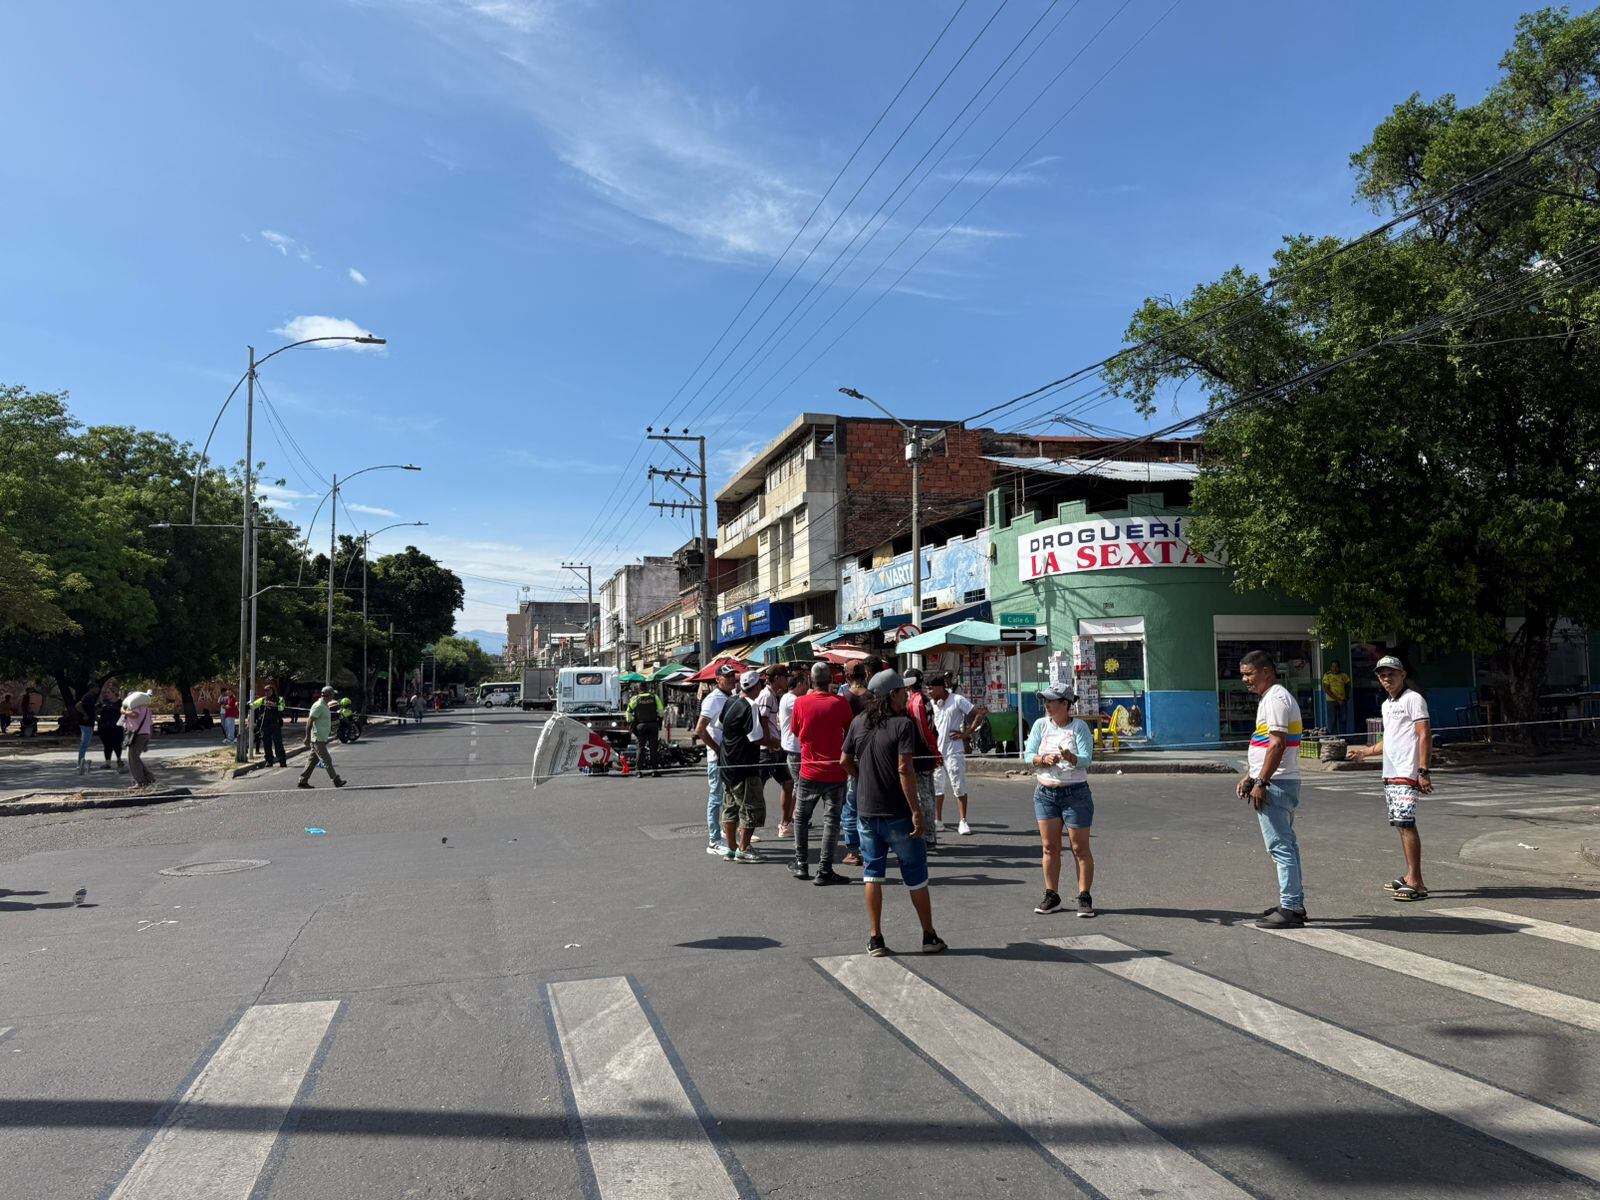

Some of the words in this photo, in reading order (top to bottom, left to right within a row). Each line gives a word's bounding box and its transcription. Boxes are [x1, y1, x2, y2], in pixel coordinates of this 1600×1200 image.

[1031, 517, 1181, 552] DROGUERÍ
[1031, 551, 1060, 576] LA
[1077, 541, 1206, 569] SEXTA
